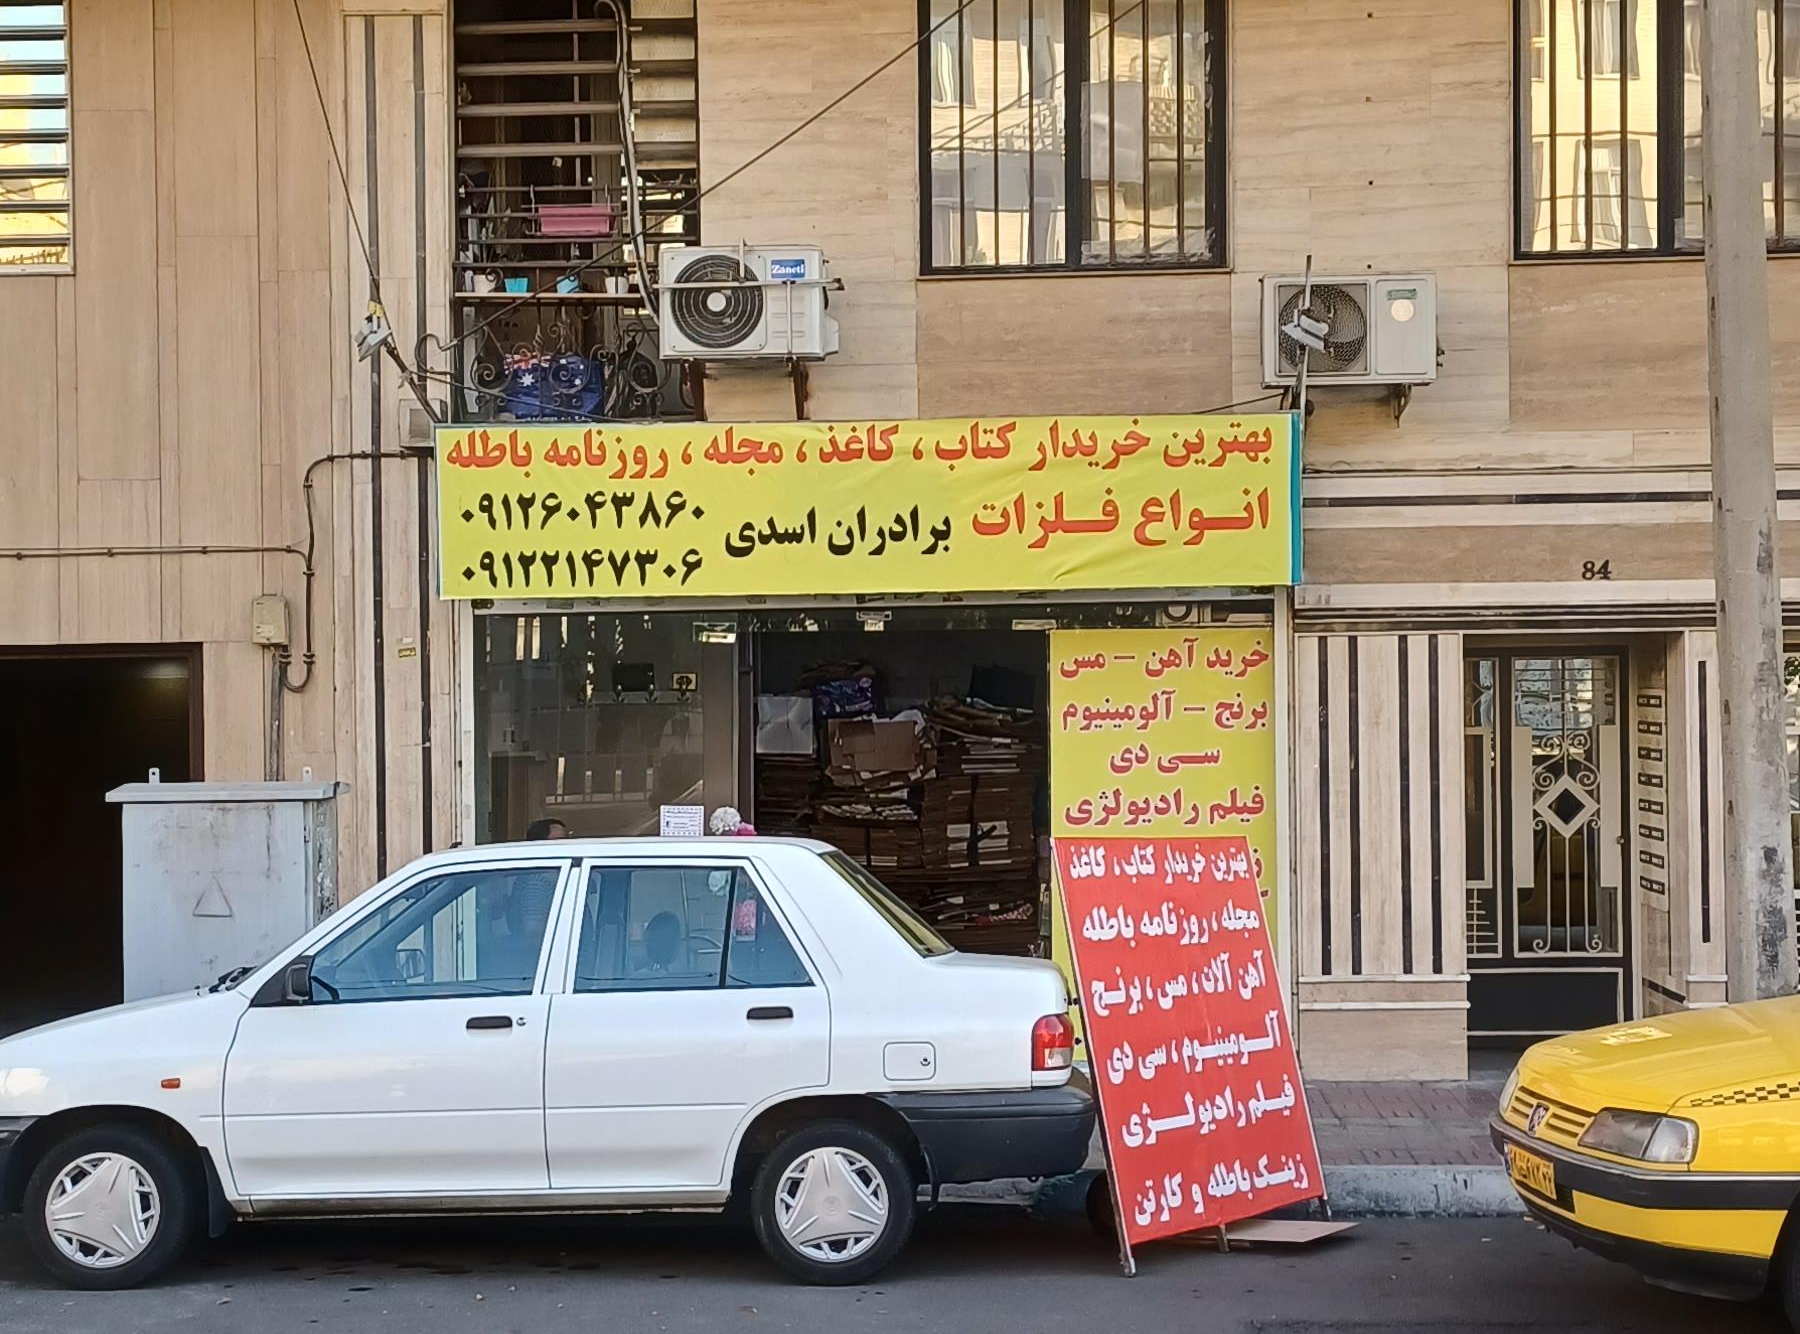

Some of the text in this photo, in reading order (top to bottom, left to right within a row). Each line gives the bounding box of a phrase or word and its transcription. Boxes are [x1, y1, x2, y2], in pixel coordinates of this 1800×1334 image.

[446, 429, 533, 478] باطله
[544, 428, 669, 479] روزنامه
[704, 427, 783, 476] مجله
[819, 423, 899, 464] کاغذ
[935, 420, 1017, 471] کتاب
[1028, 418, 1151, 471] خریدار
[1162, 421, 1273, 468] بهترین
[460, 490, 706, 531] ۰۹۱۲۶۰۴۳۸۶۰
[724, 504, 952, 558] برادران اسدی
[971, 487, 1270, 549] انواع فلزات
[461, 548, 704, 589] ۰۹۱۲۲۱۴۷۳۰۶
[1581, 559, 1612, 581] 84
[1059, 651, 1106, 679] مس
[1144, 637, 1199, 678] آهن
[1205, 639, 1270, 678] خرید
[1062, 689, 1176, 731] آلومینیوم
[1214, 692, 1268, 730] برنج
[1109, 743, 1221, 775] سی دی
[1064, 785, 1265, 826] فیلم رادیولژی
[1069, 844, 1106, 879] کاغذ
[1164, 842, 1206, 884] خریدار
[1210, 846, 1250, 882] بهترین
[1082, 904, 1136, 948] باطله
[1140, 900, 1209, 946] روزنامه
[1221, 898, 1260, 939] مجله
[1091, 965, 1144, 1017] برنج
[1157, 974, 1188, 1010] مس
[1238, 949, 1266, 1000] آهن
[1106, 1040, 1134, 1085] دی
[1138, 1043, 1167, 1080] سی
[1182, 1009, 1281, 1074] آلومینیوم
[1121, 1073, 1296, 1148] فیلم رادیولژی
[1134, 1153, 1309, 1226] زینک باطله و کارتن
